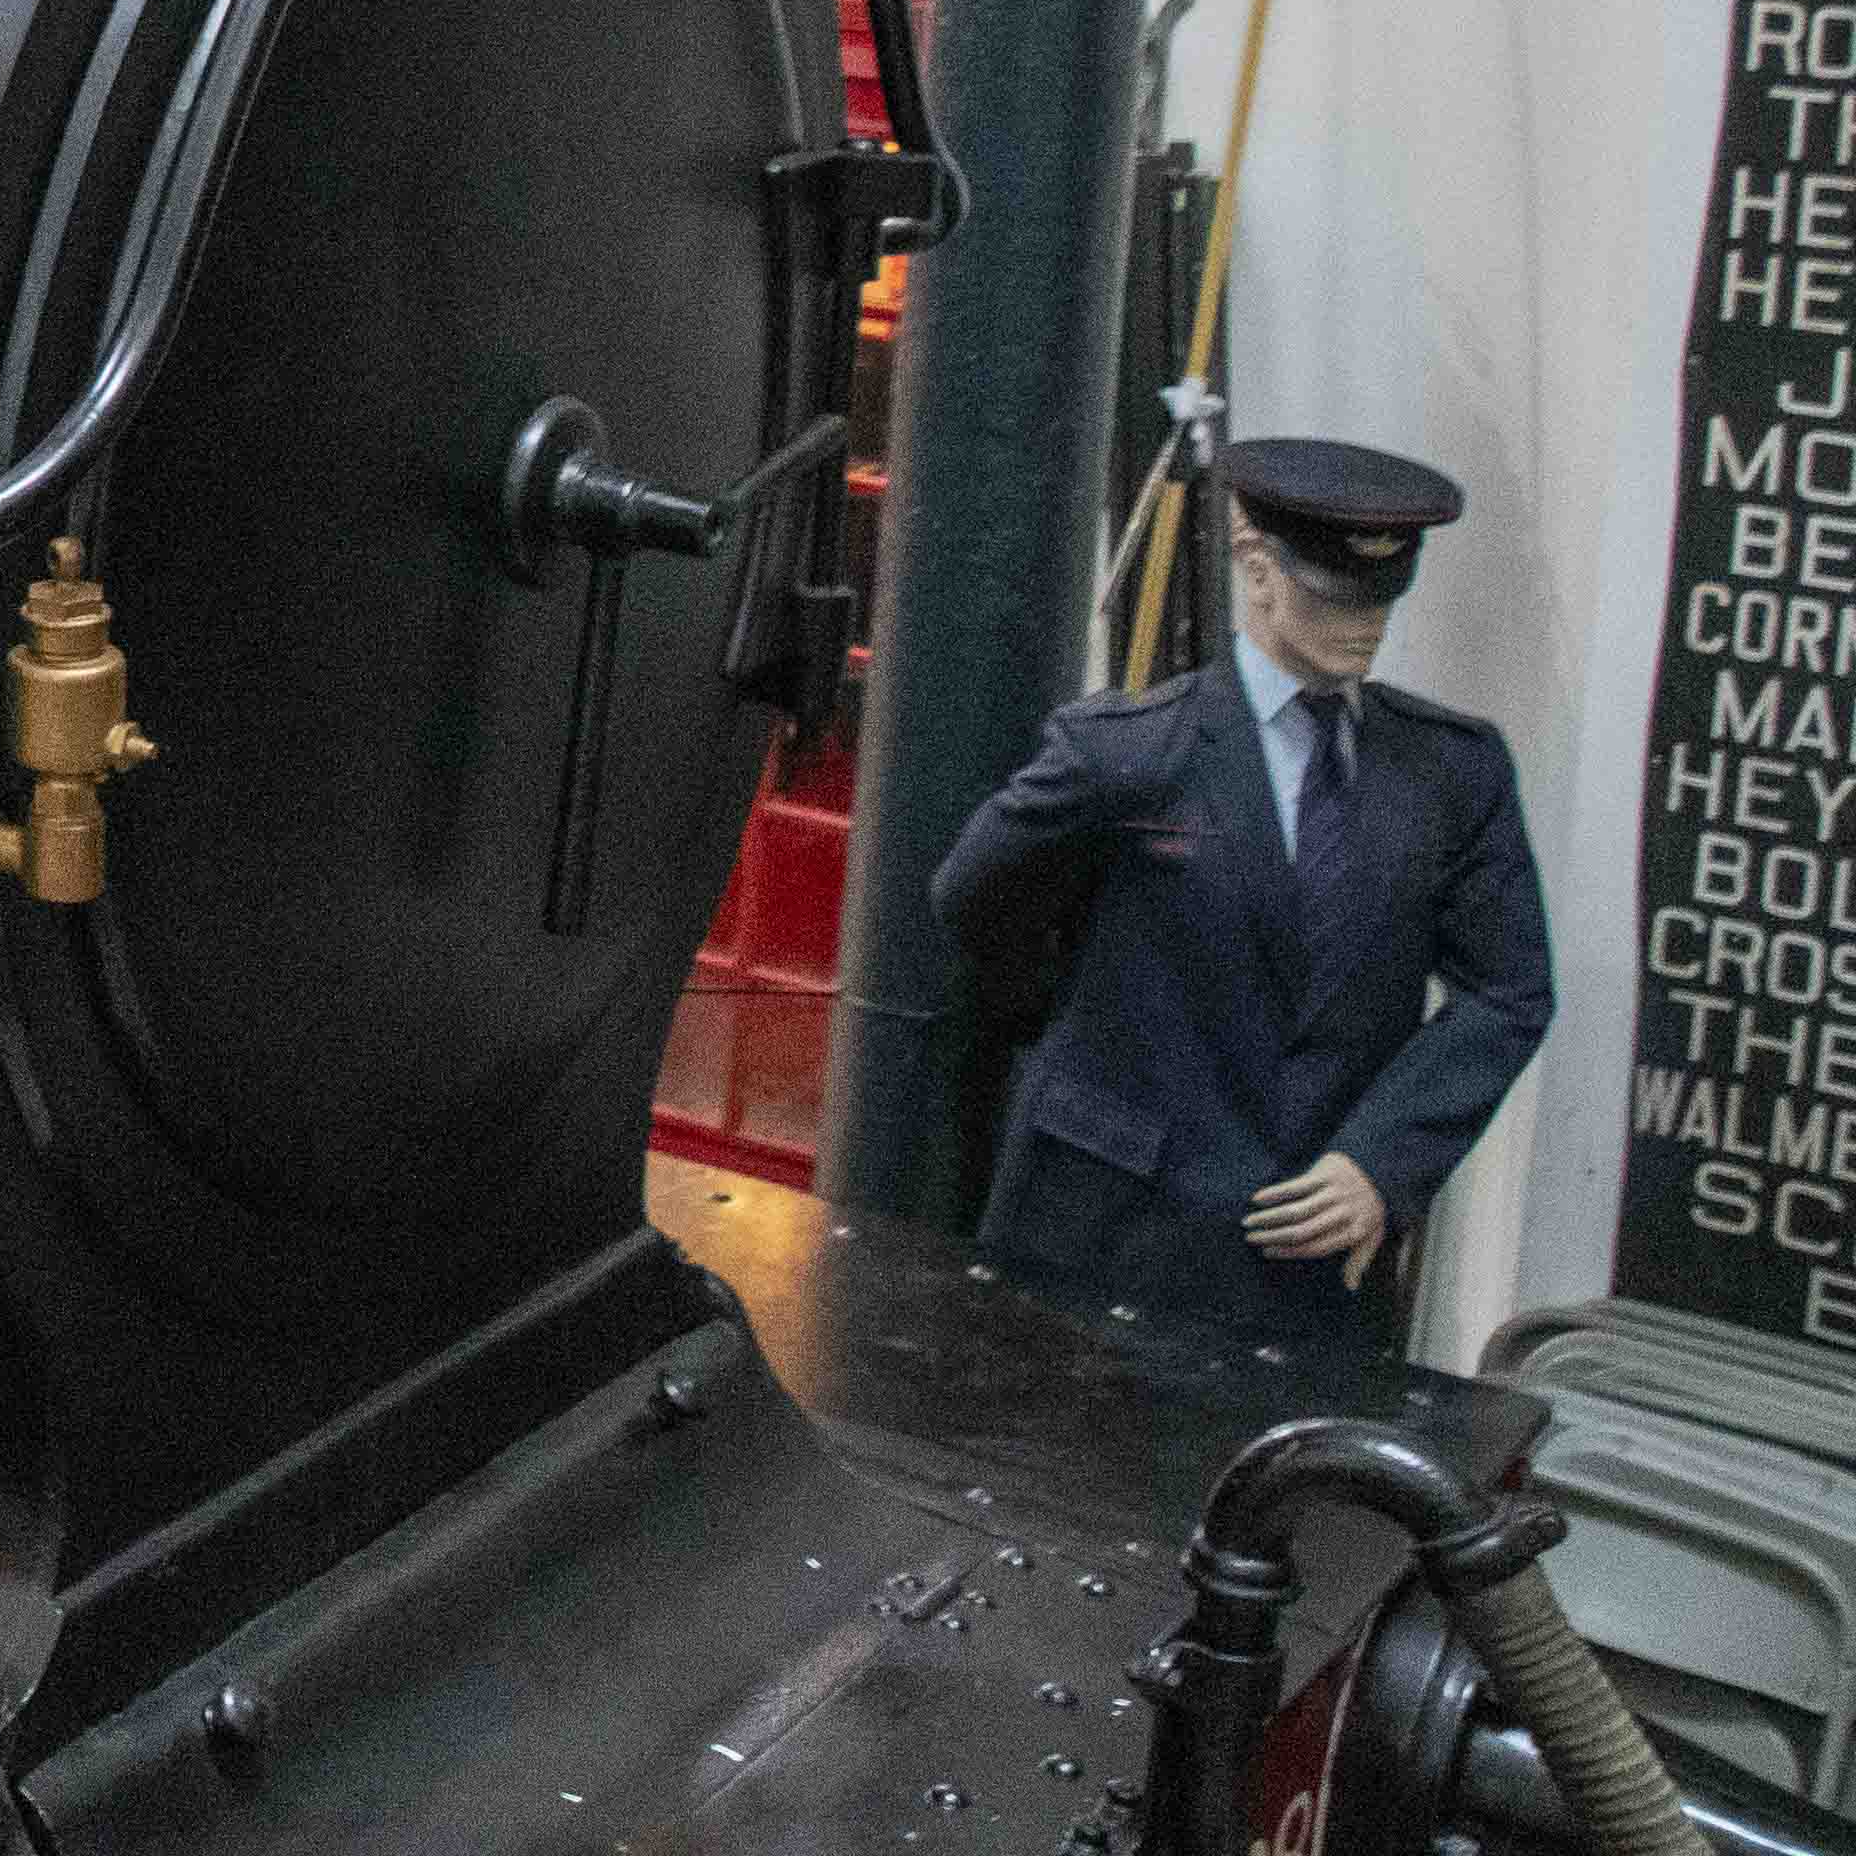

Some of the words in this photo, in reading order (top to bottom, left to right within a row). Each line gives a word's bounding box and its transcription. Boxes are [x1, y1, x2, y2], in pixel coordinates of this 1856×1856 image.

[1729, 166, 1856, 250] HE
[1720, 248, 1854, 335] HE
[1702, 414, 1856, 506] MO
[1667, 742, 1856, 843] HEY
